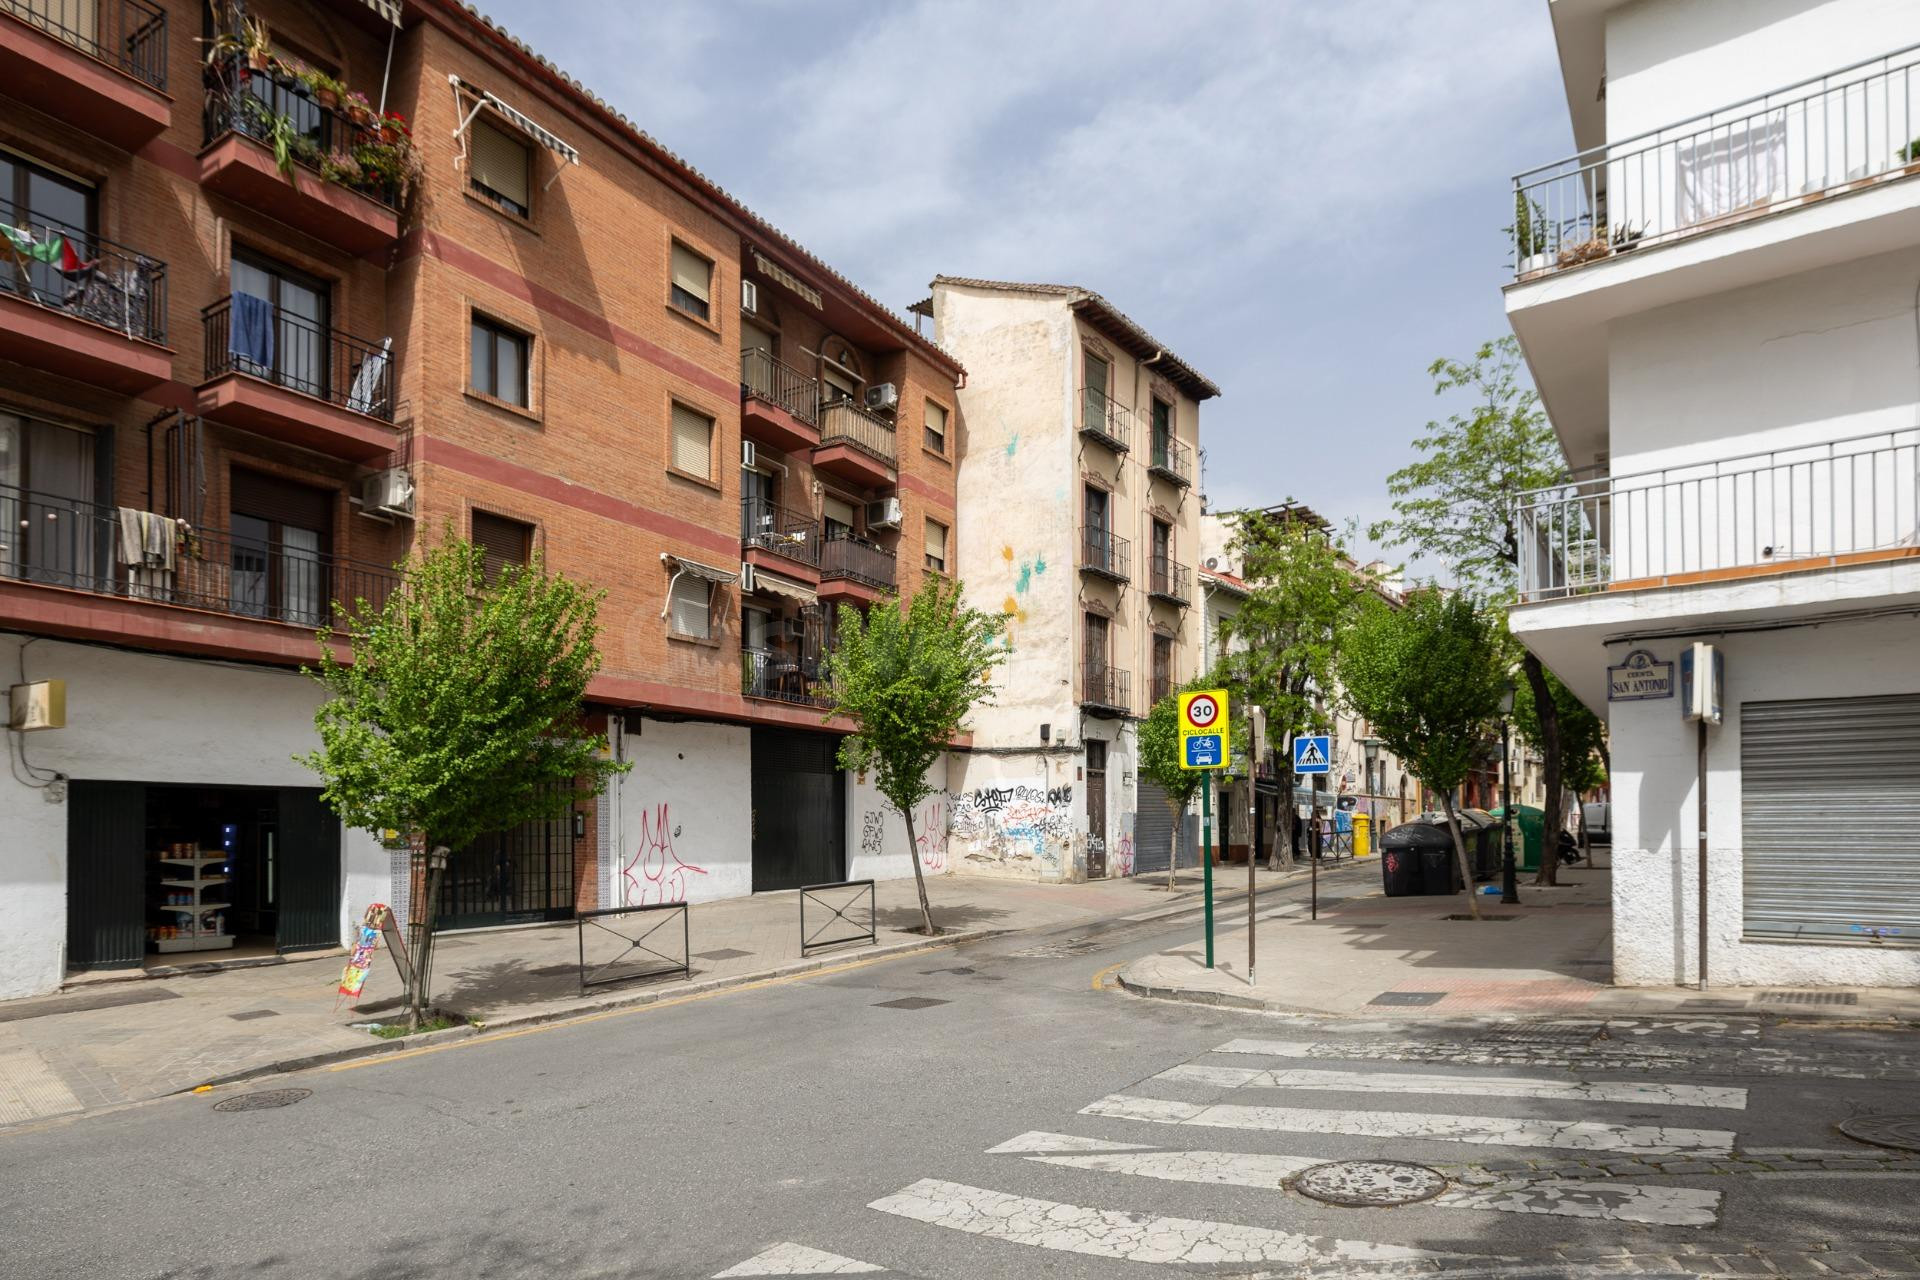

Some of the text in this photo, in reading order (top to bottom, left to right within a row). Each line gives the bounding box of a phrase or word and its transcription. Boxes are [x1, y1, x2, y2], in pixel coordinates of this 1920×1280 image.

[1613, 679, 1667, 693] SAN ANTONIO
[1193, 705, 1212, 717] 30
[1182, 727, 1225, 736] CICLOCALLE
